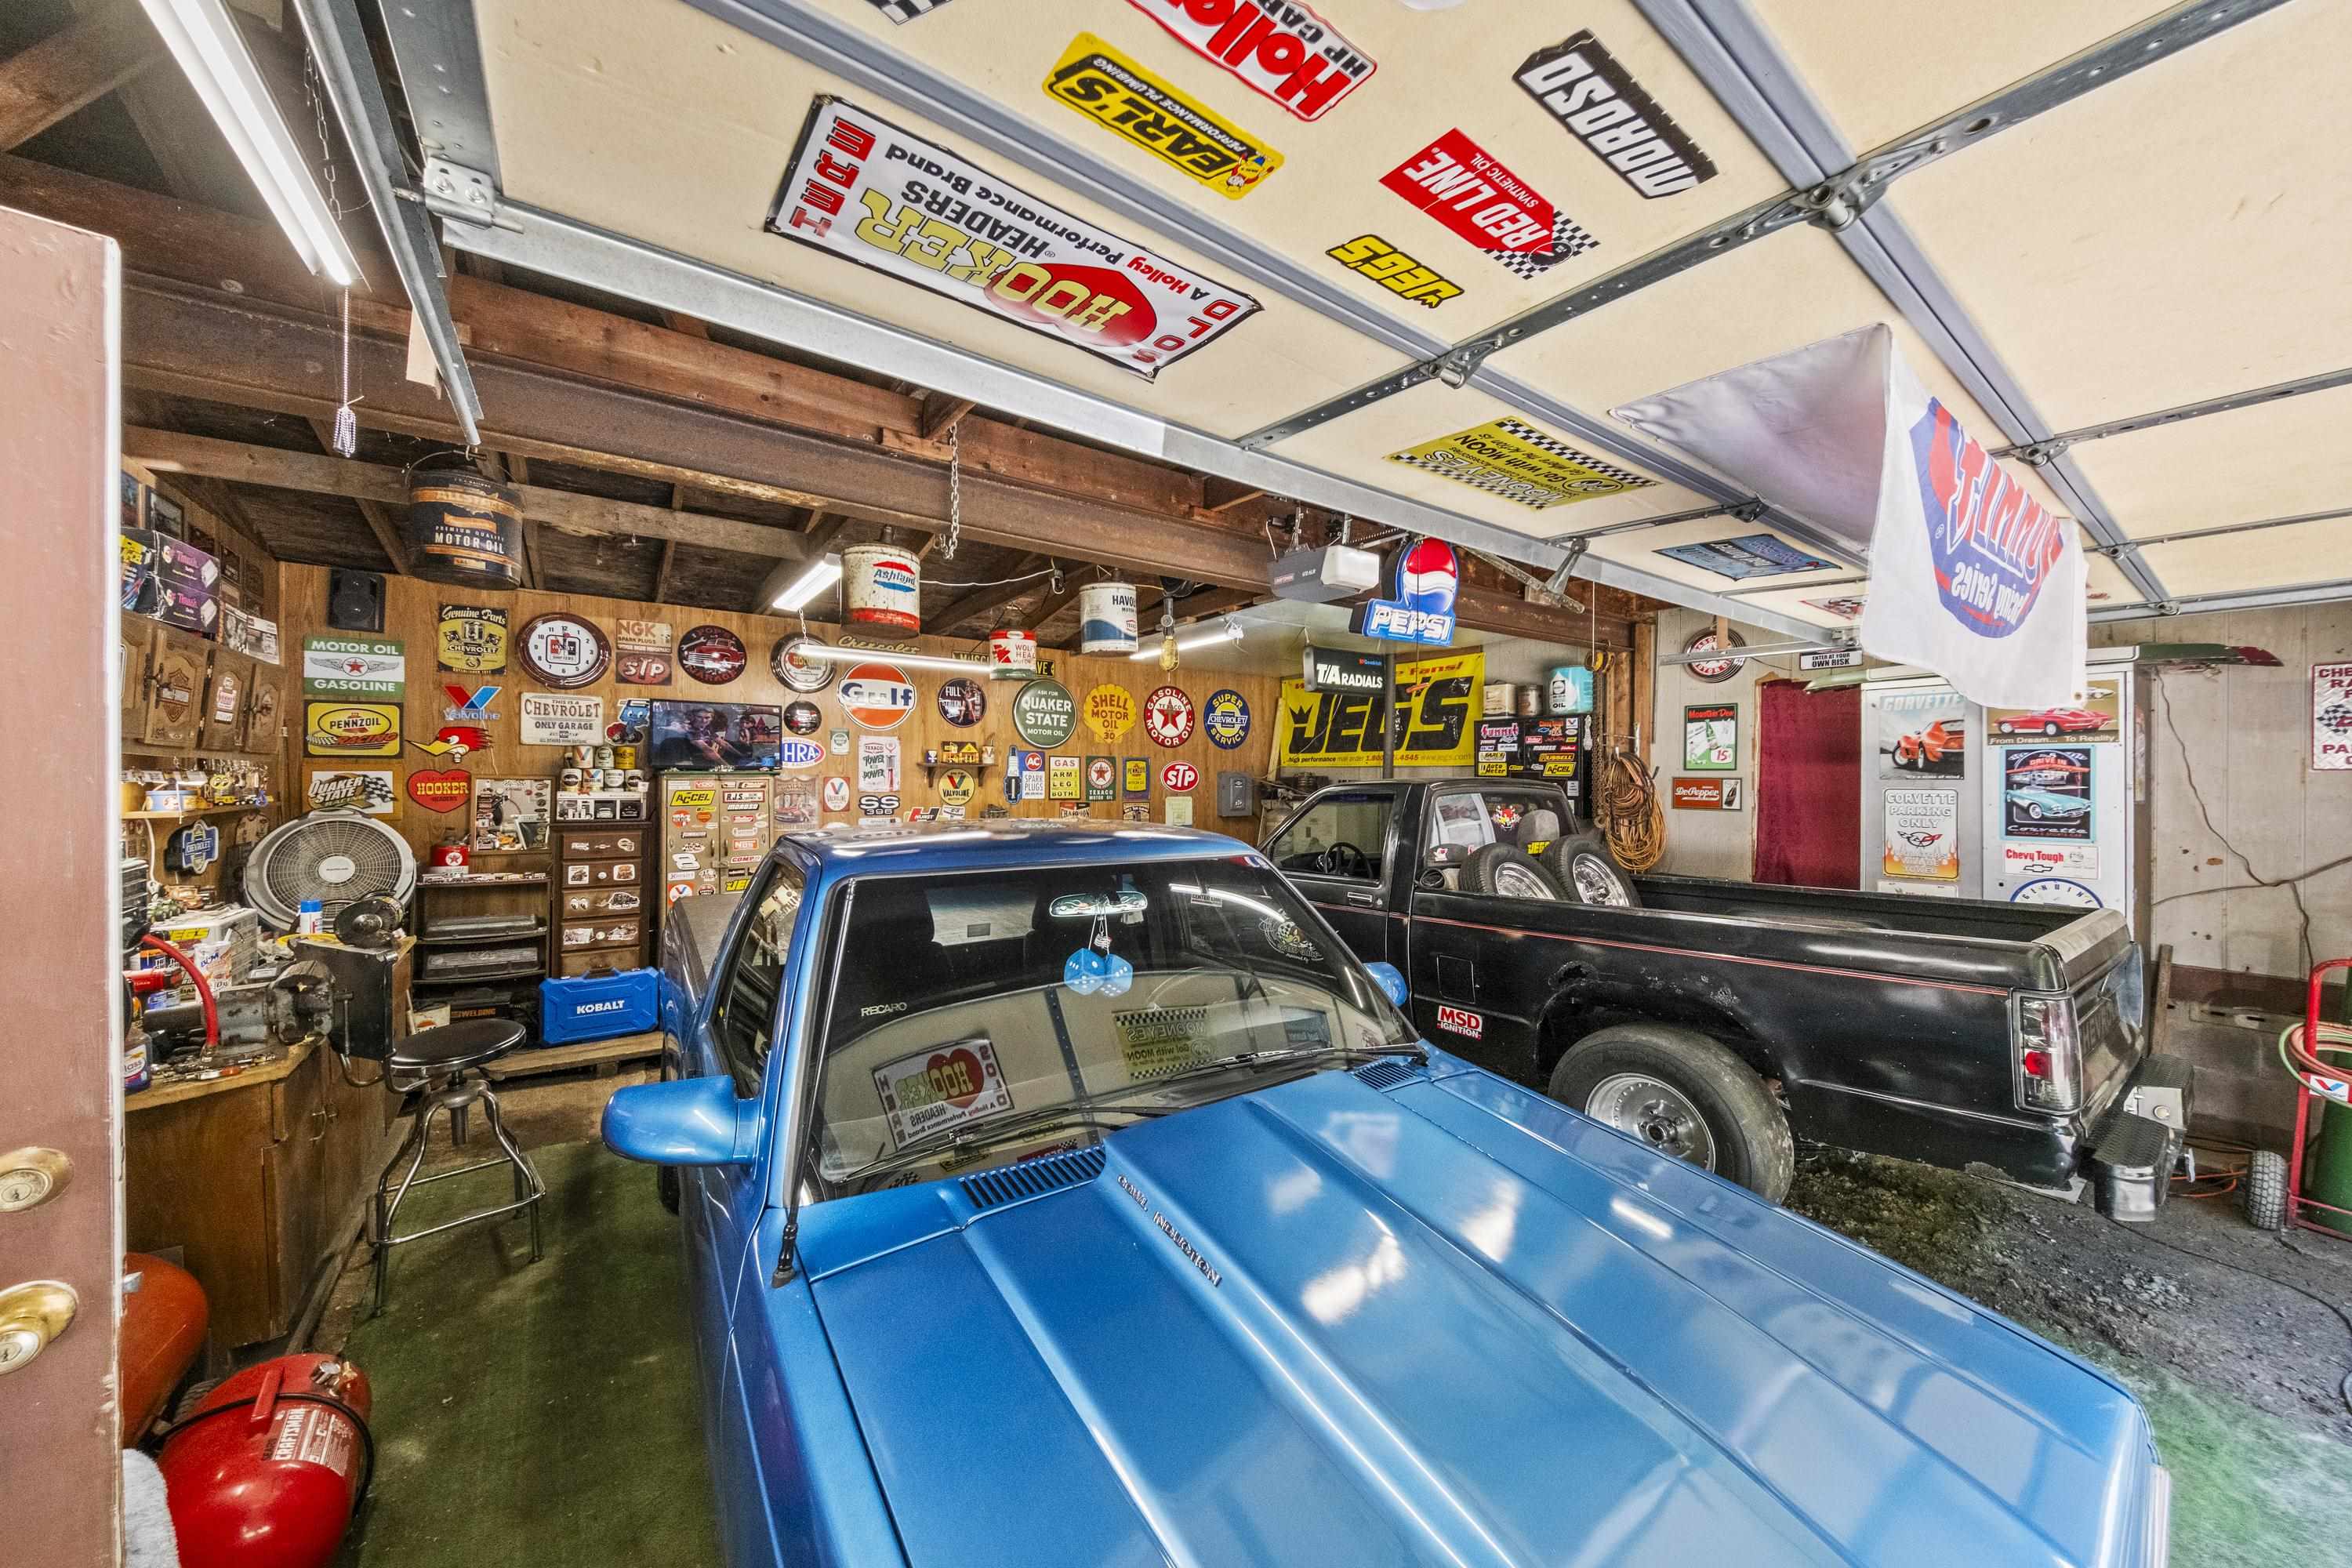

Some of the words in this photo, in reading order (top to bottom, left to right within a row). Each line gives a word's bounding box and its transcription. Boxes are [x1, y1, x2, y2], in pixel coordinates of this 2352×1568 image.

[1258, 0, 1323, 45] CAR
[1323, 45, 1367, 78] HP
[1093, 57, 1162, 101] PLUMBING
[1063, 77, 1236, 173] EARL'S
[1160, 99, 1247, 152] PERFORMANCE
[1519, 52, 1696, 198] MOROSO
[885, 144, 973, 195] Brand
[1472, 153, 1490, 172] OIL
[1403, 151, 1486, 210] LINE
[1486, 167, 1538, 209] SYNTHETIC
[902, 180, 1044, 257] HEADERS
[976, 177, 1124, 265] Performance
[1473, 202, 1549, 249] RED
[855, 187, 1134, 333] HOOKER
[1127, 257, 1187, 294] Holley
[1190, 286, 1208, 300] A
[1454, 434, 1506, 460] MOON
[1504, 457, 1541, 476] with
[1425, 451, 1565, 503] MOONEYES
[1541, 470, 1568, 483] Go!
[435, 532, 480, 548] MOTOR
[486, 540, 504, 554] OIL
[874, 568, 916, 586] Ashland
[442, 604, 479, 620] Genuine
[481, 609, 506, 625] Parts
[1370, 604, 1452, 641] PEPSI
[618, 622, 655, 637] NGK
[311, 641, 370, 654] MOTOR
[373, 644, 398, 655] OIL
[448, 644, 498, 653] CHEVROLET
[838, 635, 920, 655] Chevrolet
[625, 657, 664, 679] STP
[1831, 658, 1849, 666] RISK
[1316, 664, 1341, 684] T/A
[1342, 676, 1383, 688] RADIALS
[314, 680, 396, 691] GASOLINE
[946, 687, 961, 697] FULL
[842, 683, 913, 706] Gulf
[1091, 694, 1128, 710] SHELL
[1147, 689, 1192, 712] GASOLINE
[1212, 695, 1243, 708] SUPER
[1883, 693, 1966, 711] CORVETTE
[524, 699, 601, 718] CHEVROLET
[1022, 696, 1072, 713] QUAKER
[443, 708, 501, 720] Valvoline
[1025, 713, 1068, 727] STATE
[1091, 710, 1129, 720] MOTOR
[1210, 714, 1247, 726] CHEVROLET
[1688, 710, 1719, 719] Mountain
[1720, 708, 1735, 717] Dew
[330, 719, 381, 729] PENNZOIL
[535, 721, 556, 730] ONLY
[558, 722, 593, 731] GARAGE
[1102, 720, 1119, 730] OIL
[1146, 719, 1179, 745] MOTOR
[1181, 718, 1193, 739] OIL
[337, 732, 398, 745] RACING
[1104, 731, 1116, 740] 30
[1210, 728, 1245, 745] SERVICE
[1989, 736, 2014, 745] From
[785, 743, 816, 762] HRA
[1026, 757, 1042, 768] AC
[1024, 774, 1043, 783] SPARK
[1163, 766, 1197, 786] STP
[308, 776, 364, 795] QUAKER
[417, 782, 468, 795] HOOKER
[942, 789, 969, 797] VALVOLINE
[1024, 783, 1044, 792] PLUGS
[1687, 786, 1719, 798] Pepper
[315, 789, 358, 804] STATE
[676, 793, 710, 804] ACCEL
[860, 797, 899, 809] SS
[1887, 793, 1955, 806] CORVETTE
[1889, 806, 1951, 817] PARKING
[1899, 818, 1940, 829] ONLY
[2007, 825, 2088, 834] Corvette
[2006, 849, 2034, 862] Chevy
[2036, 851, 2064, 863] Tough
[576, 1000, 625, 1014] KOBALT
[861, 1002, 908, 1016] RECARO
[1439, 1007, 1481, 1030] MSD
[1441, 1022, 1479, 1039] IGNITION
[1153, 1211, 1222, 1287] INDUCTION
[275, 1408, 306, 1461] CRAFTSMAN
